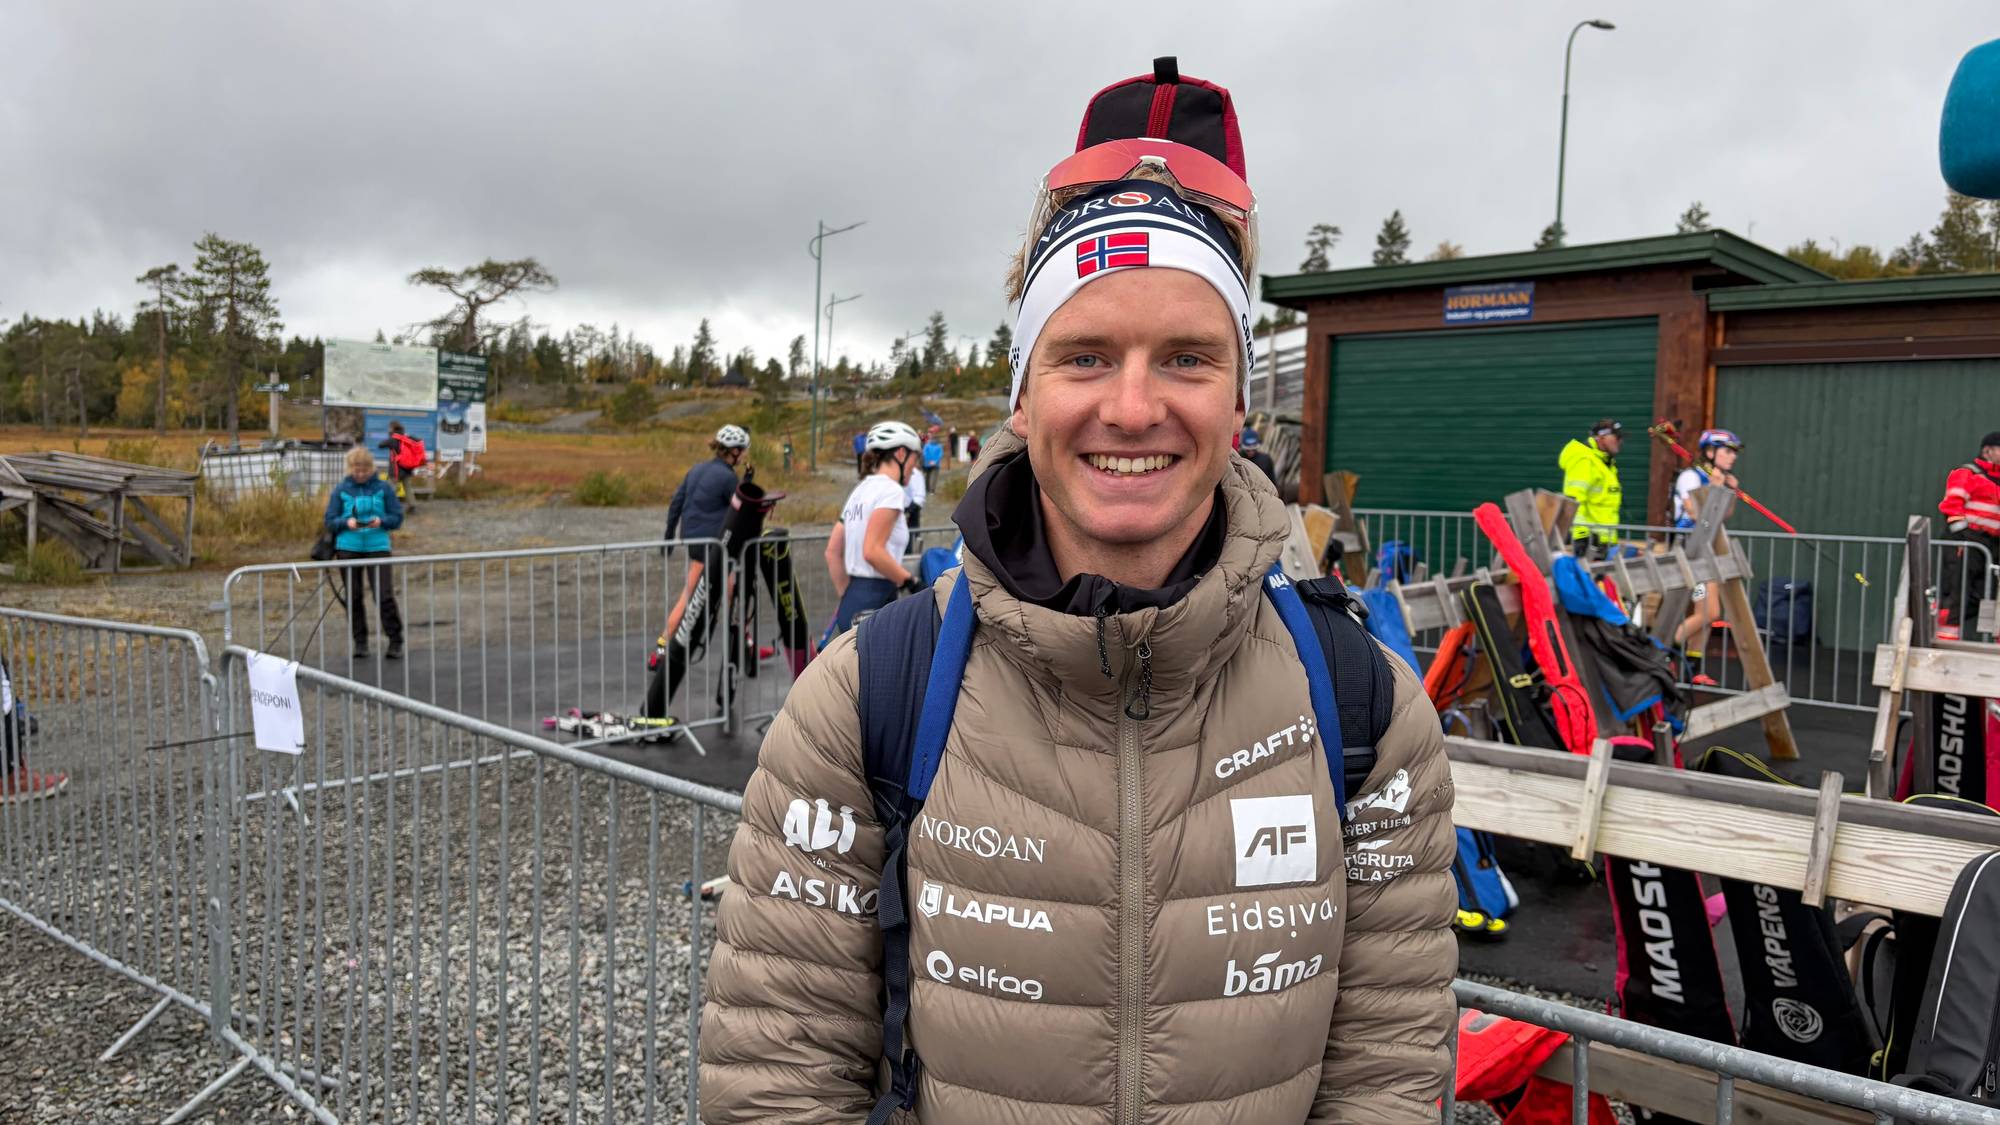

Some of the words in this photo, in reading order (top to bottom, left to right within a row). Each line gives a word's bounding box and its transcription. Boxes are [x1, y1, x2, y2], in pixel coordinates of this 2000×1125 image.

[1033, 191, 1209, 259] NORSAN
[1215, 725, 1297, 779] CRAFT
[783, 799, 857, 854] ALI
[919, 814, 1047, 864] NORSAN
[1243, 824, 1307, 858] AF
[1380, 814, 1412, 830] HJEM
[945, 893, 1054, 933] LAPUA
[958, 964, 1044, 1000] elfag
